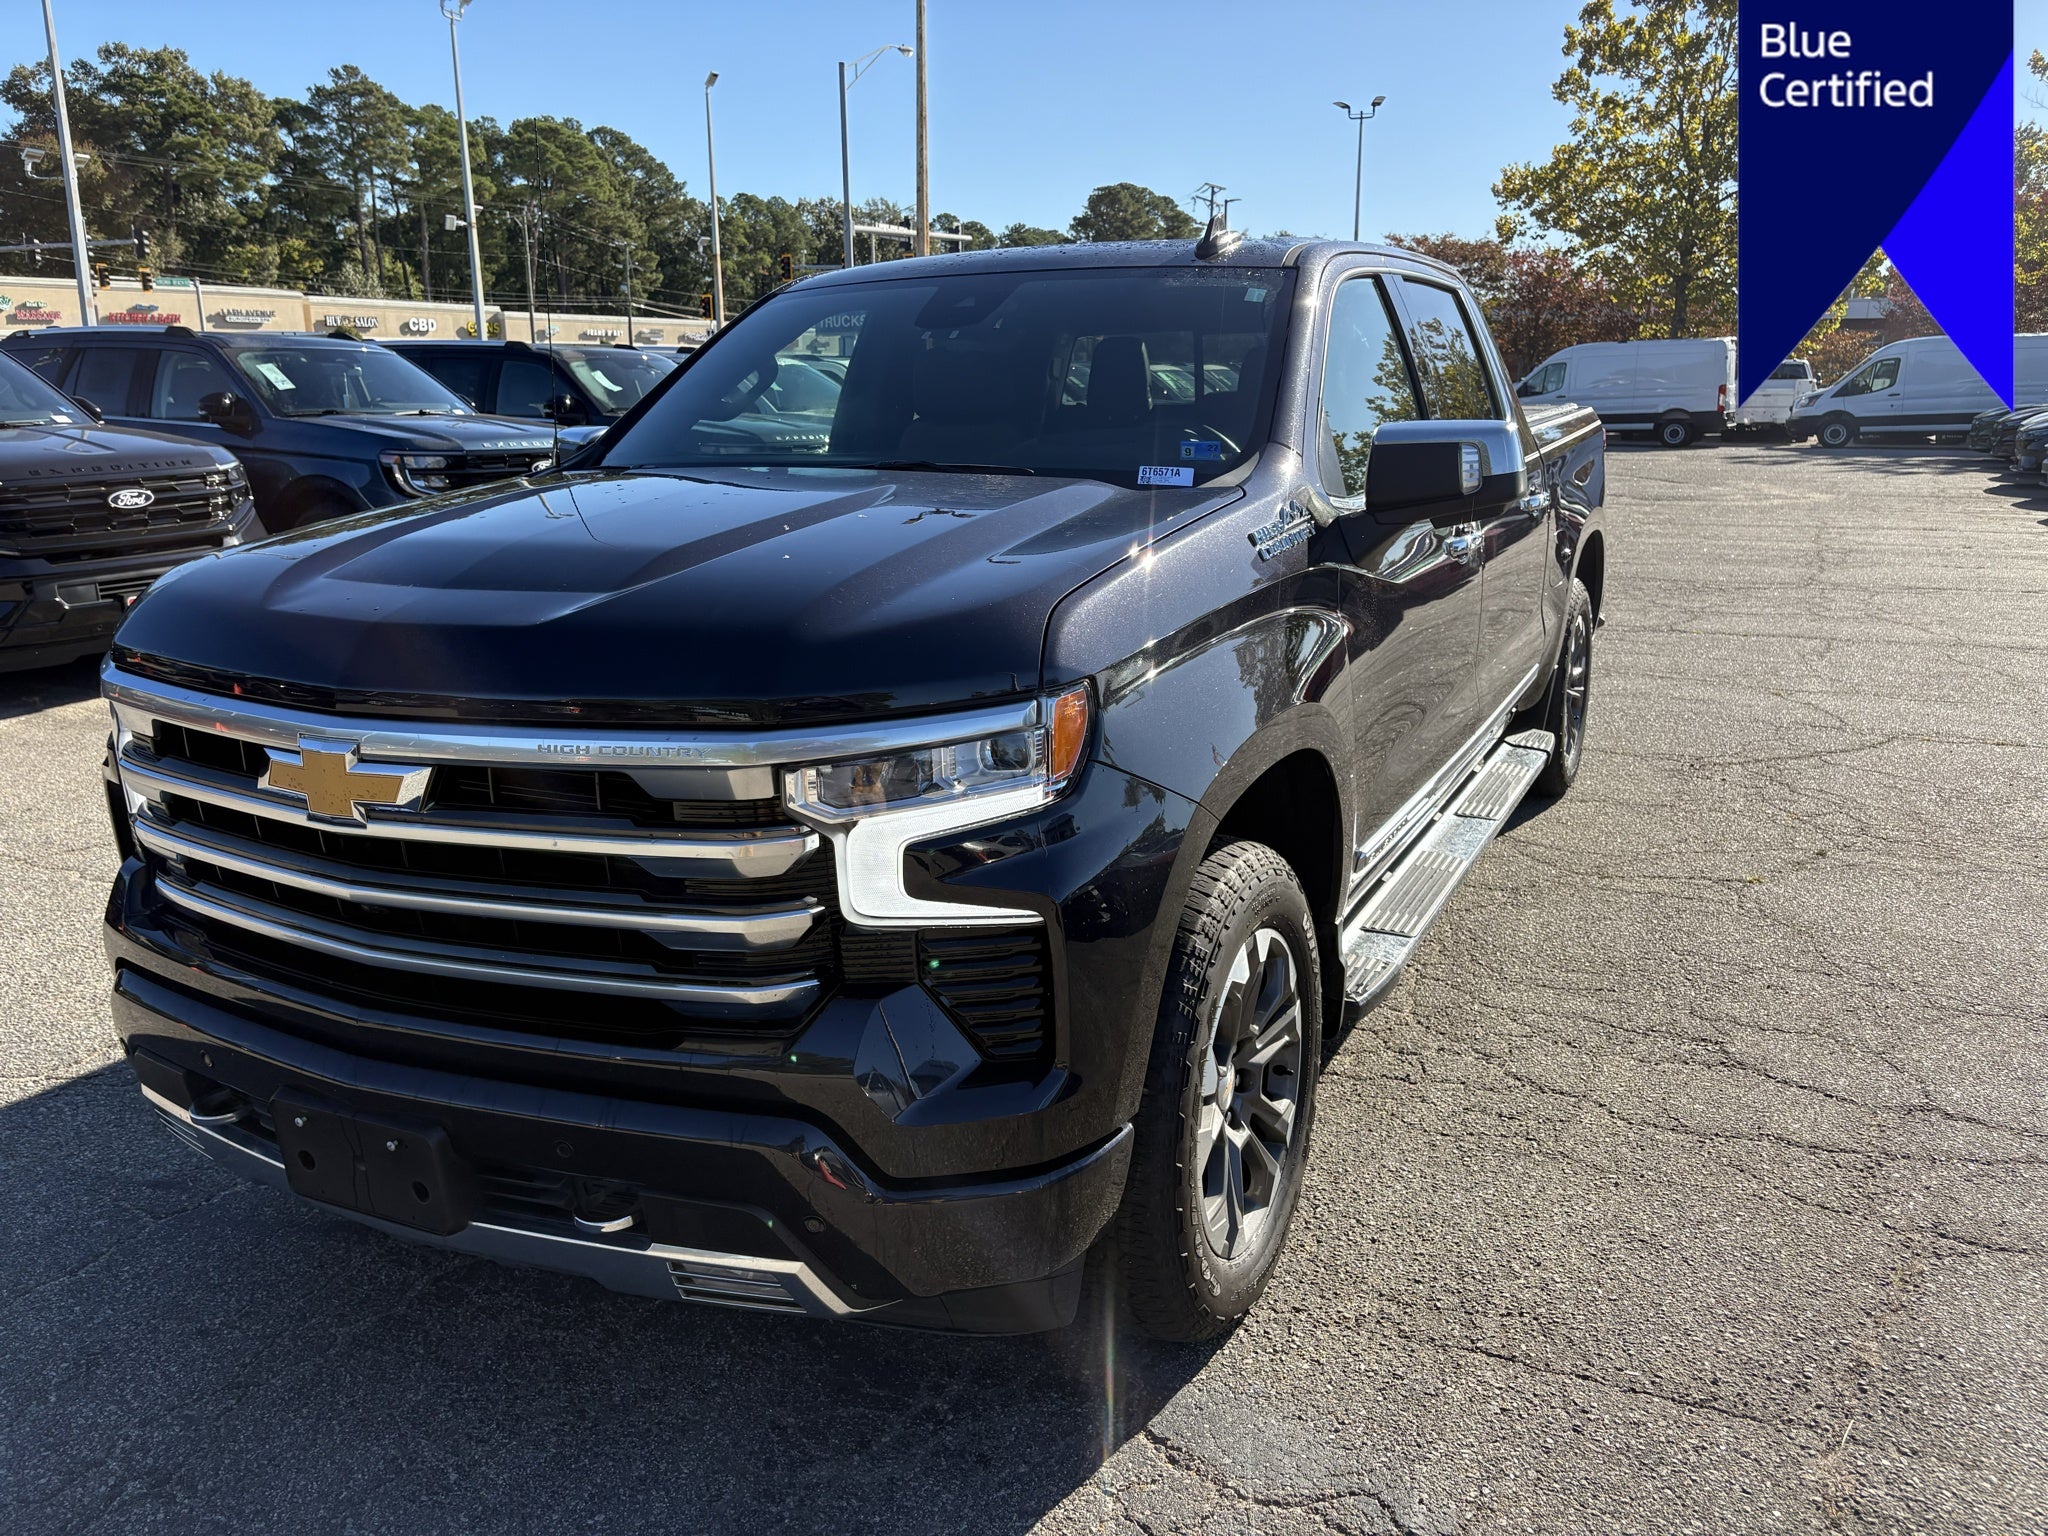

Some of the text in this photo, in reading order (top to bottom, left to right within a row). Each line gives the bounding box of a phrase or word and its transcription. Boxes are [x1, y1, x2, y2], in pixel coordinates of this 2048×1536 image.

[16, 309, 62, 321] MASSAGE
[109, 312, 148, 323] KITCHEN
[158, 313, 181, 324] BATH
[819, 314, 866, 328] TRUCKS
[354, 317, 379, 328] SALON
[409, 317, 437, 332] CBD
[467, 321, 500, 333] CNS
[1184, 447, 1192, 457] 9
[28, 459, 192, 477] EXPEDITION
[1141, 467, 1181, 477] 6T6571A
[117, 492, 146, 506] Ford
[537, 744, 711, 758] HIGH COUNTRY
